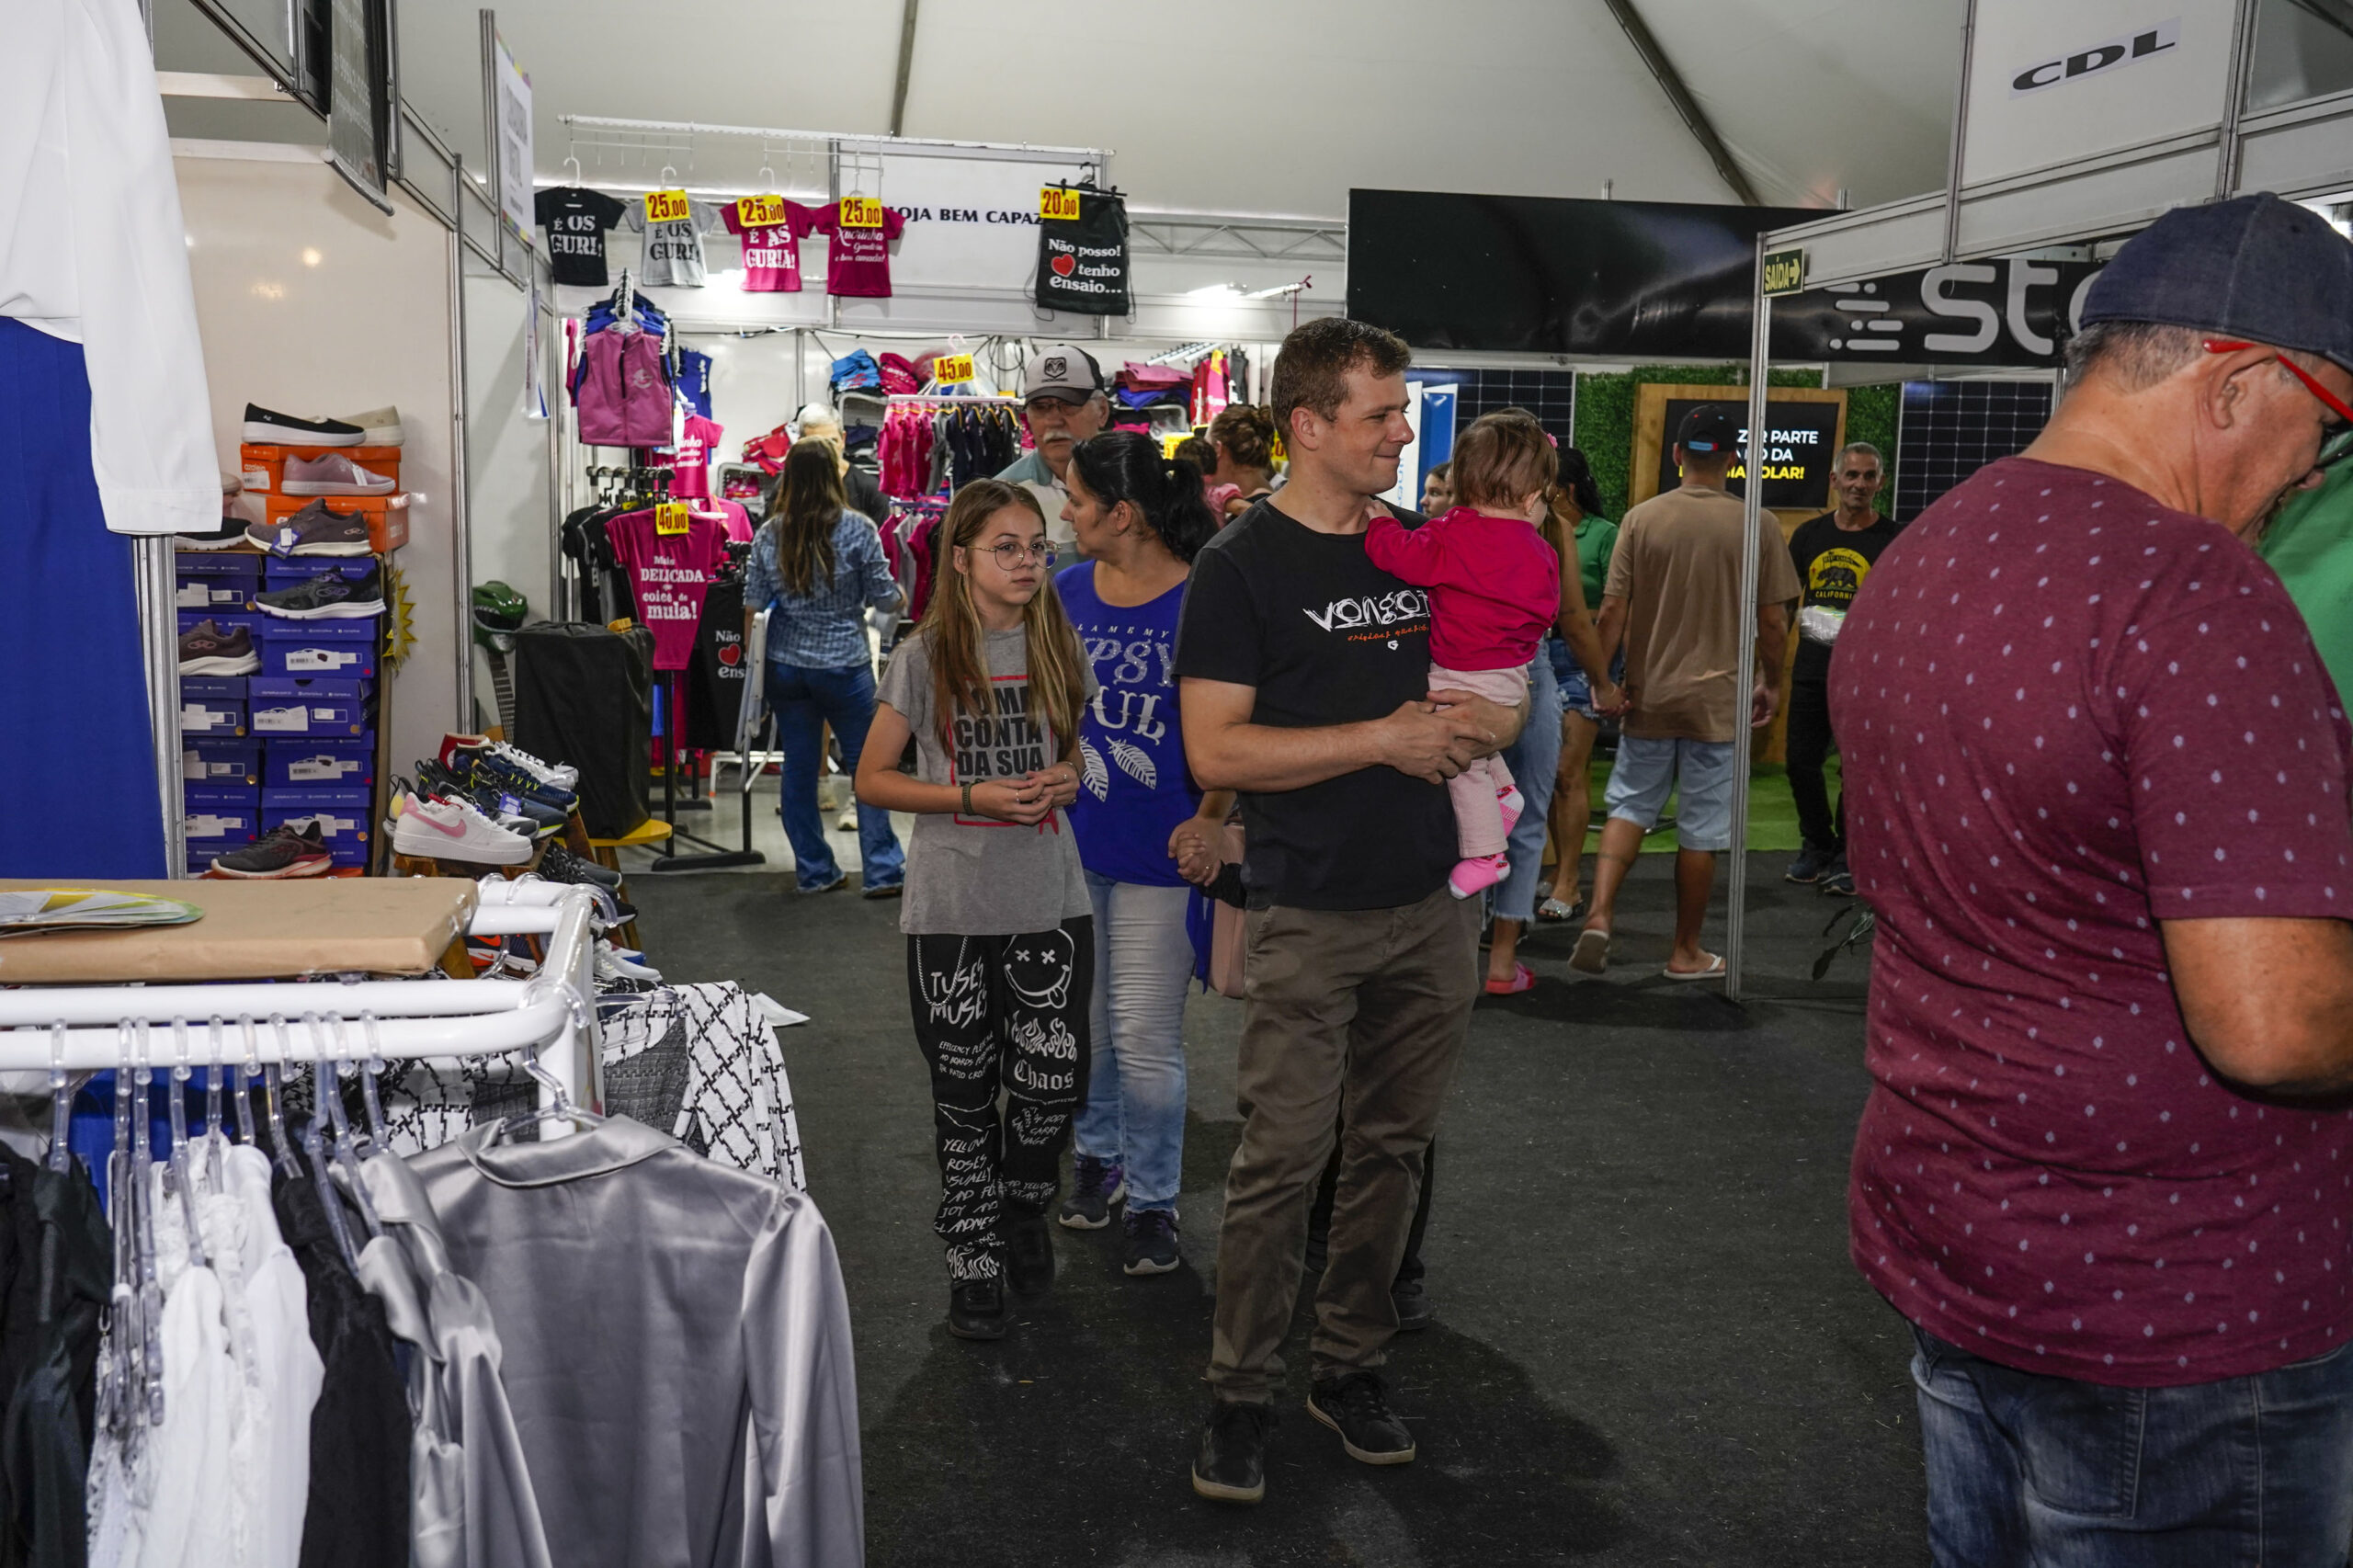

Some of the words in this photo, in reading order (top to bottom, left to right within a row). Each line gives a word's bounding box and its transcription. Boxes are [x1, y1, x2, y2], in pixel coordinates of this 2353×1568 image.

[2012, 30, 2176, 90] CDL
[648, 194, 688, 219] 25,00
[742, 198, 784, 222] 25,00
[843, 199, 881, 224] 25,00
[1042, 189, 1077, 216] 20,00
[567, 215, 596, 232] OS
[890, 206, 933, 222] OJA
[939, 209, 979, 223] BEM
[985, 210, 1044, 225] CAPAZ
[667, 222, 692, 238] OS
[767, 224, 791, 247] AS
[550, 234, 603, 257] GURI!
[650, 243, 700, 263] GURI!
[1048, 238, 1074, 254] Não
[1077, 244, 1121, 258] posso!
[745, 248, 796, 269] GURIA!
[1078, 263, 1120, 278] tenho
[1764, 256, 1790, 292] SAÍDA
[1049, 276, 1122, 294] ensaio...
[938, 357, 972, 381] 45,00
[1770, 430, 1818, 444] PARTE
[1771, 448, 1793, 461] DA
[1762, 465, 1805, 479] OLAR!
[640, 568, 706, 584] DELICADA
[1815, 590, 1854, 600] CALIFORNI
[646, 600, 699, 620] mula!
[715, 630, 741, 642] Não
[717, 665, 745, 678] ens
[958, 750, 992, 776] DA
[996, 745, 1045, 776] SUA
[1014, 1058, 1074, 1091] Chaos
[942, 1130, 990, 1153] YELLOW
[946, 1153, 987, 1173] ROSES
[938, 1204, 967, 1220] JOY
